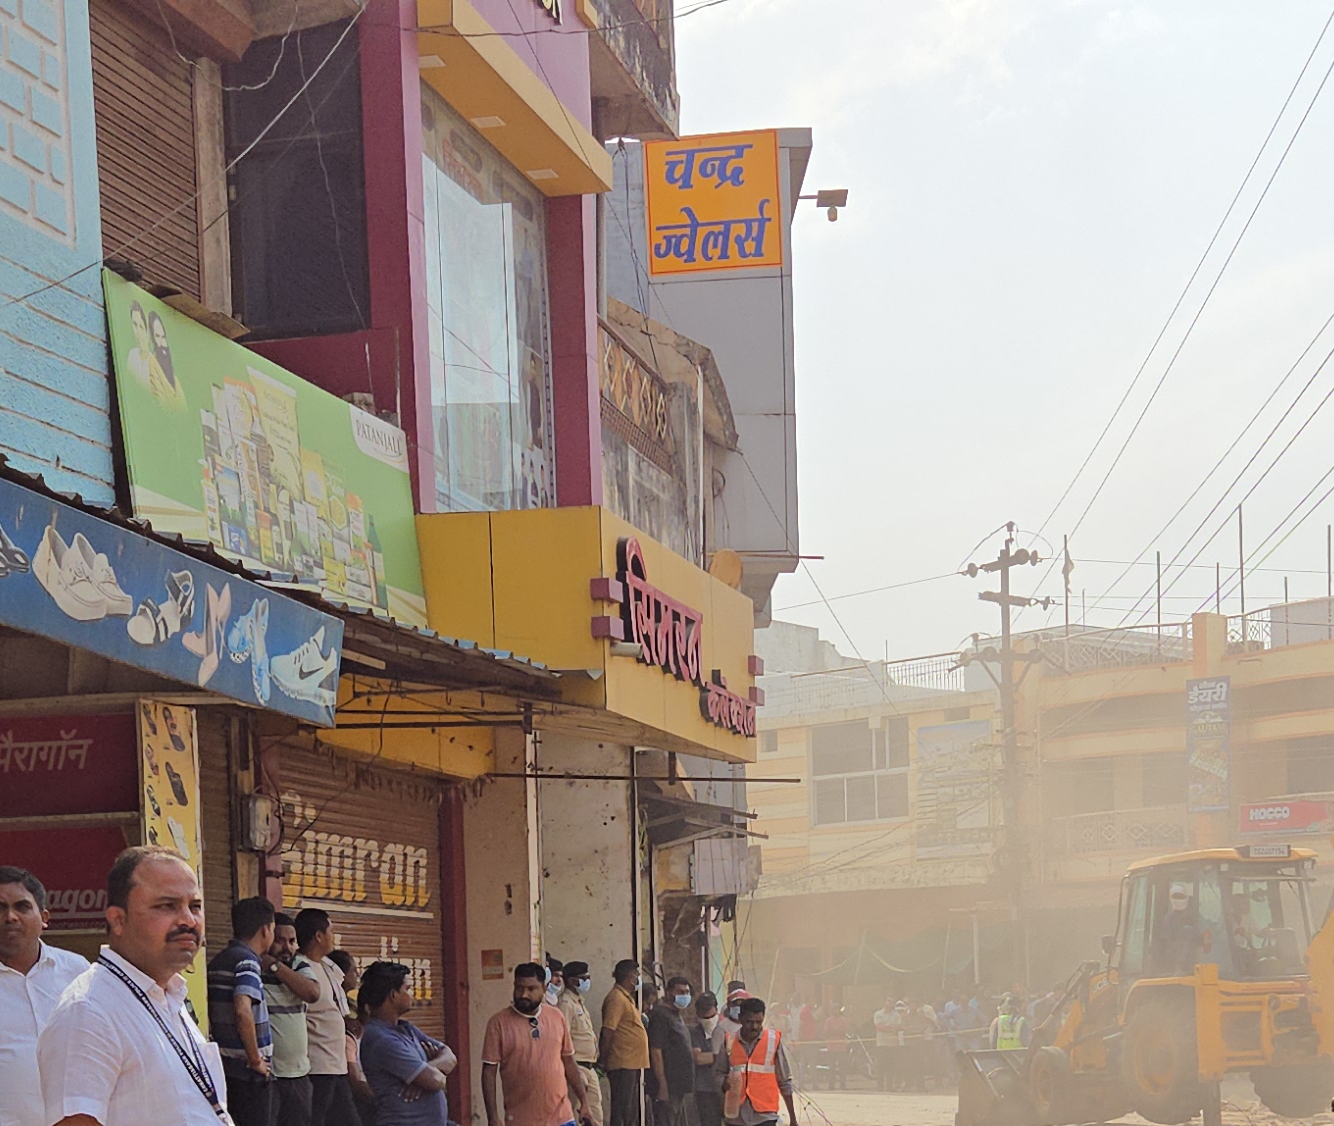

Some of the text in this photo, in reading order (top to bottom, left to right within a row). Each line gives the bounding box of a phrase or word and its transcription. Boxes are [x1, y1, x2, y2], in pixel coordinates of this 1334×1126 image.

[665, 144, 753, 189] चन्द्र
[654, 199, 771, 263] ज्वेलर्स
[1249, 806, 1290, 821] HOCCO
